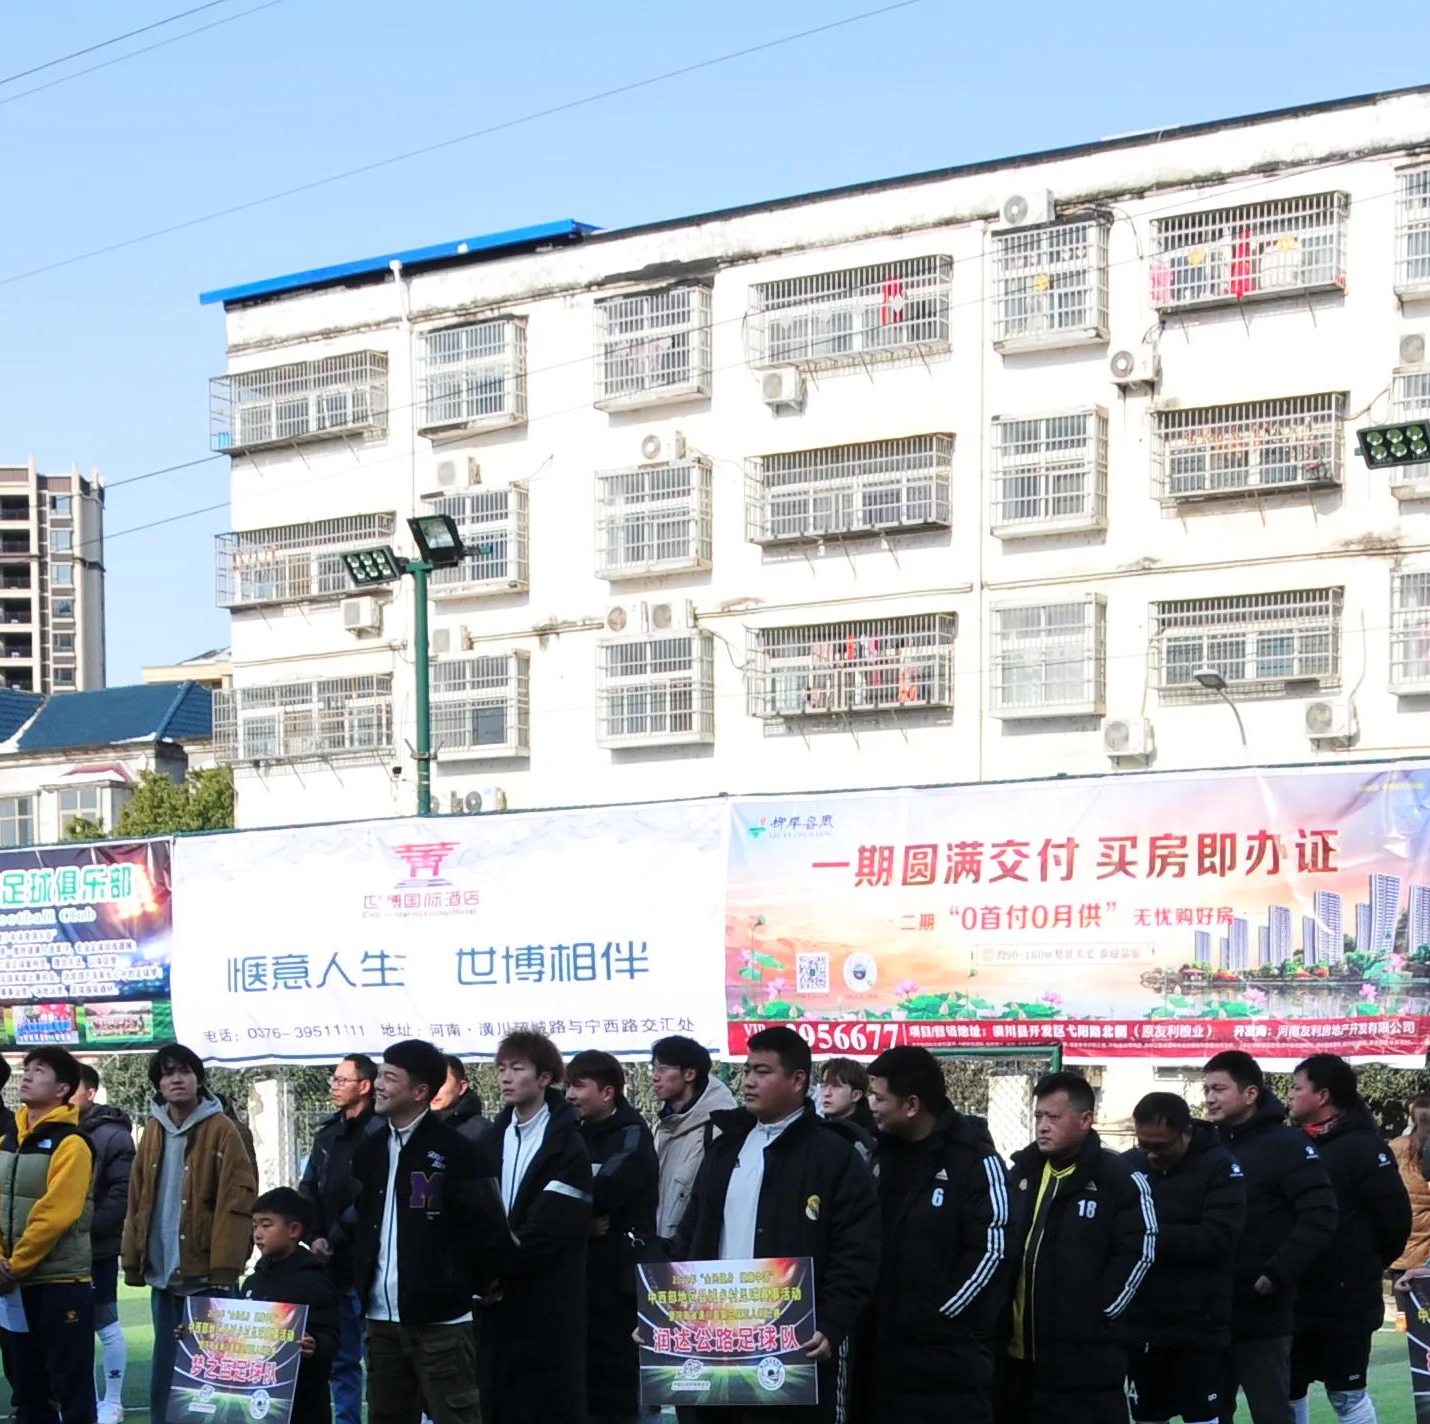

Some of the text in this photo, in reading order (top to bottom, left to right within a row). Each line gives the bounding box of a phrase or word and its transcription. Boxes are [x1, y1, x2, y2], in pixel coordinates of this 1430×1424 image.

[811, 828, 1340, 889] 一期圆满交付 买房即办证
[899, 913, 936, 933] 二期
[1133, 906, 1235, 928] 无忧购好房
[226, 941, 650, 994] 惬意人生 世博相伴
[931, 1187, 945, 1208] 6
[1077, 1199, 1098, 1219] 18
[653, 1324, 801, 1353] 润达公路足球队
